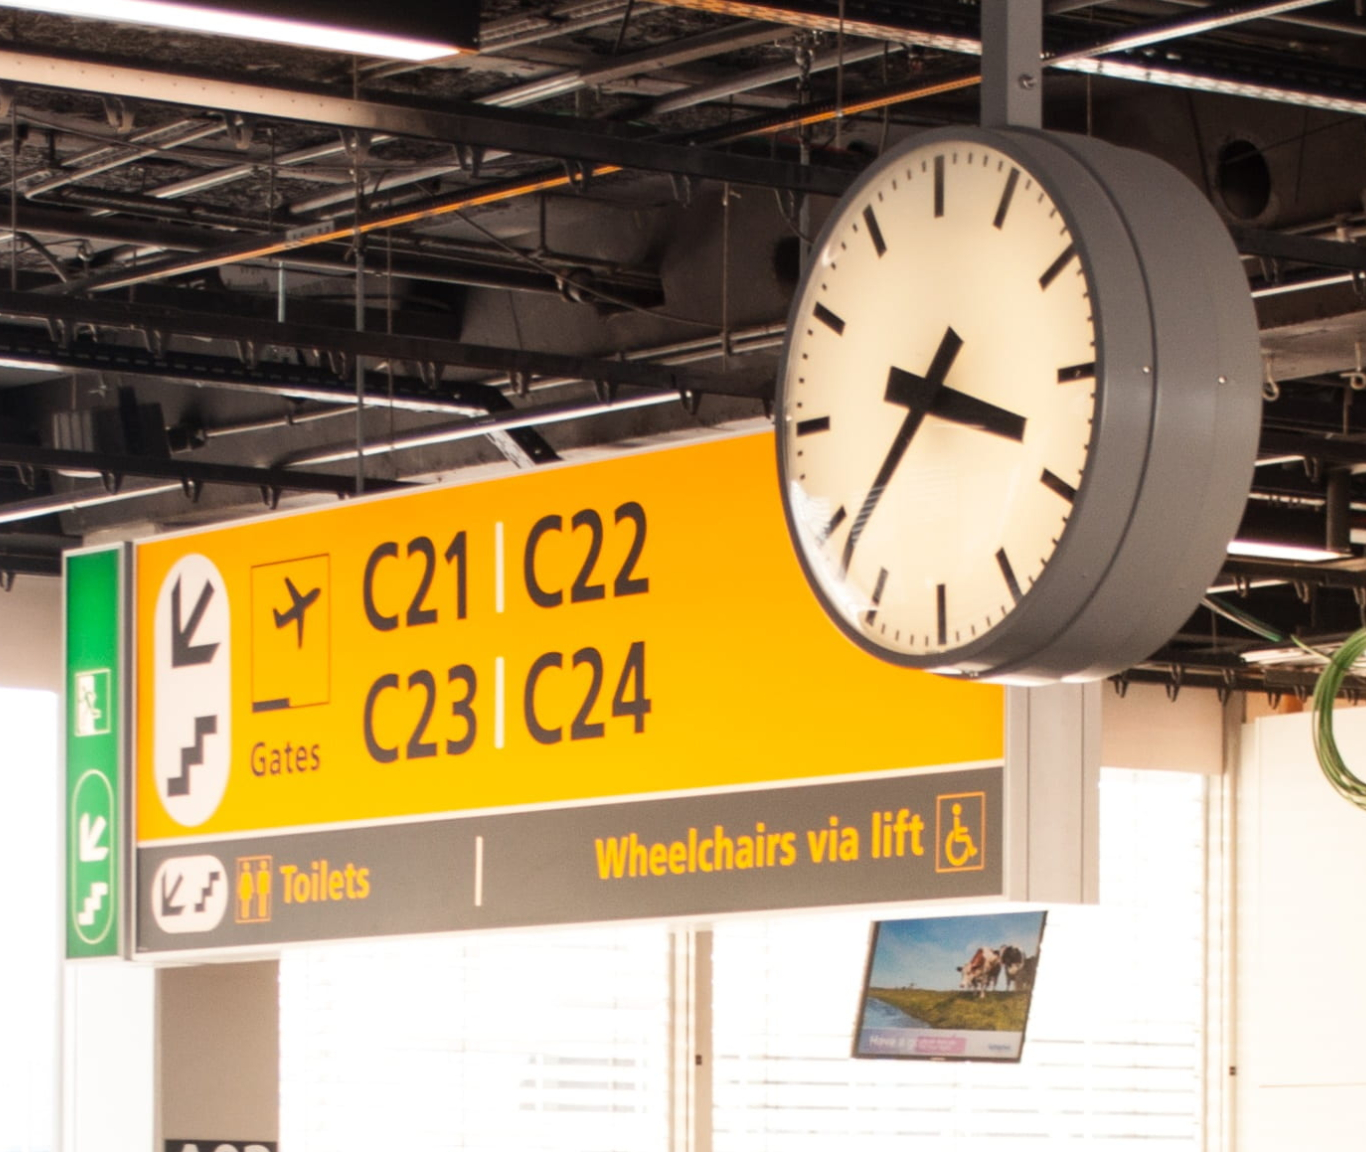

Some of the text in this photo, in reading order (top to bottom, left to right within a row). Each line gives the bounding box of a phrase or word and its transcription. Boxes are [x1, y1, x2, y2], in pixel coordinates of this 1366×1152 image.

[363, 501, 649, 632] C21 C22
[363, 641, 652, 764] C23 C24
[251, 741, 320, 777] Gates
[595, 809, 924, 880] Wheelchairs via lift
[280, 859, 371, 904] Toilets
